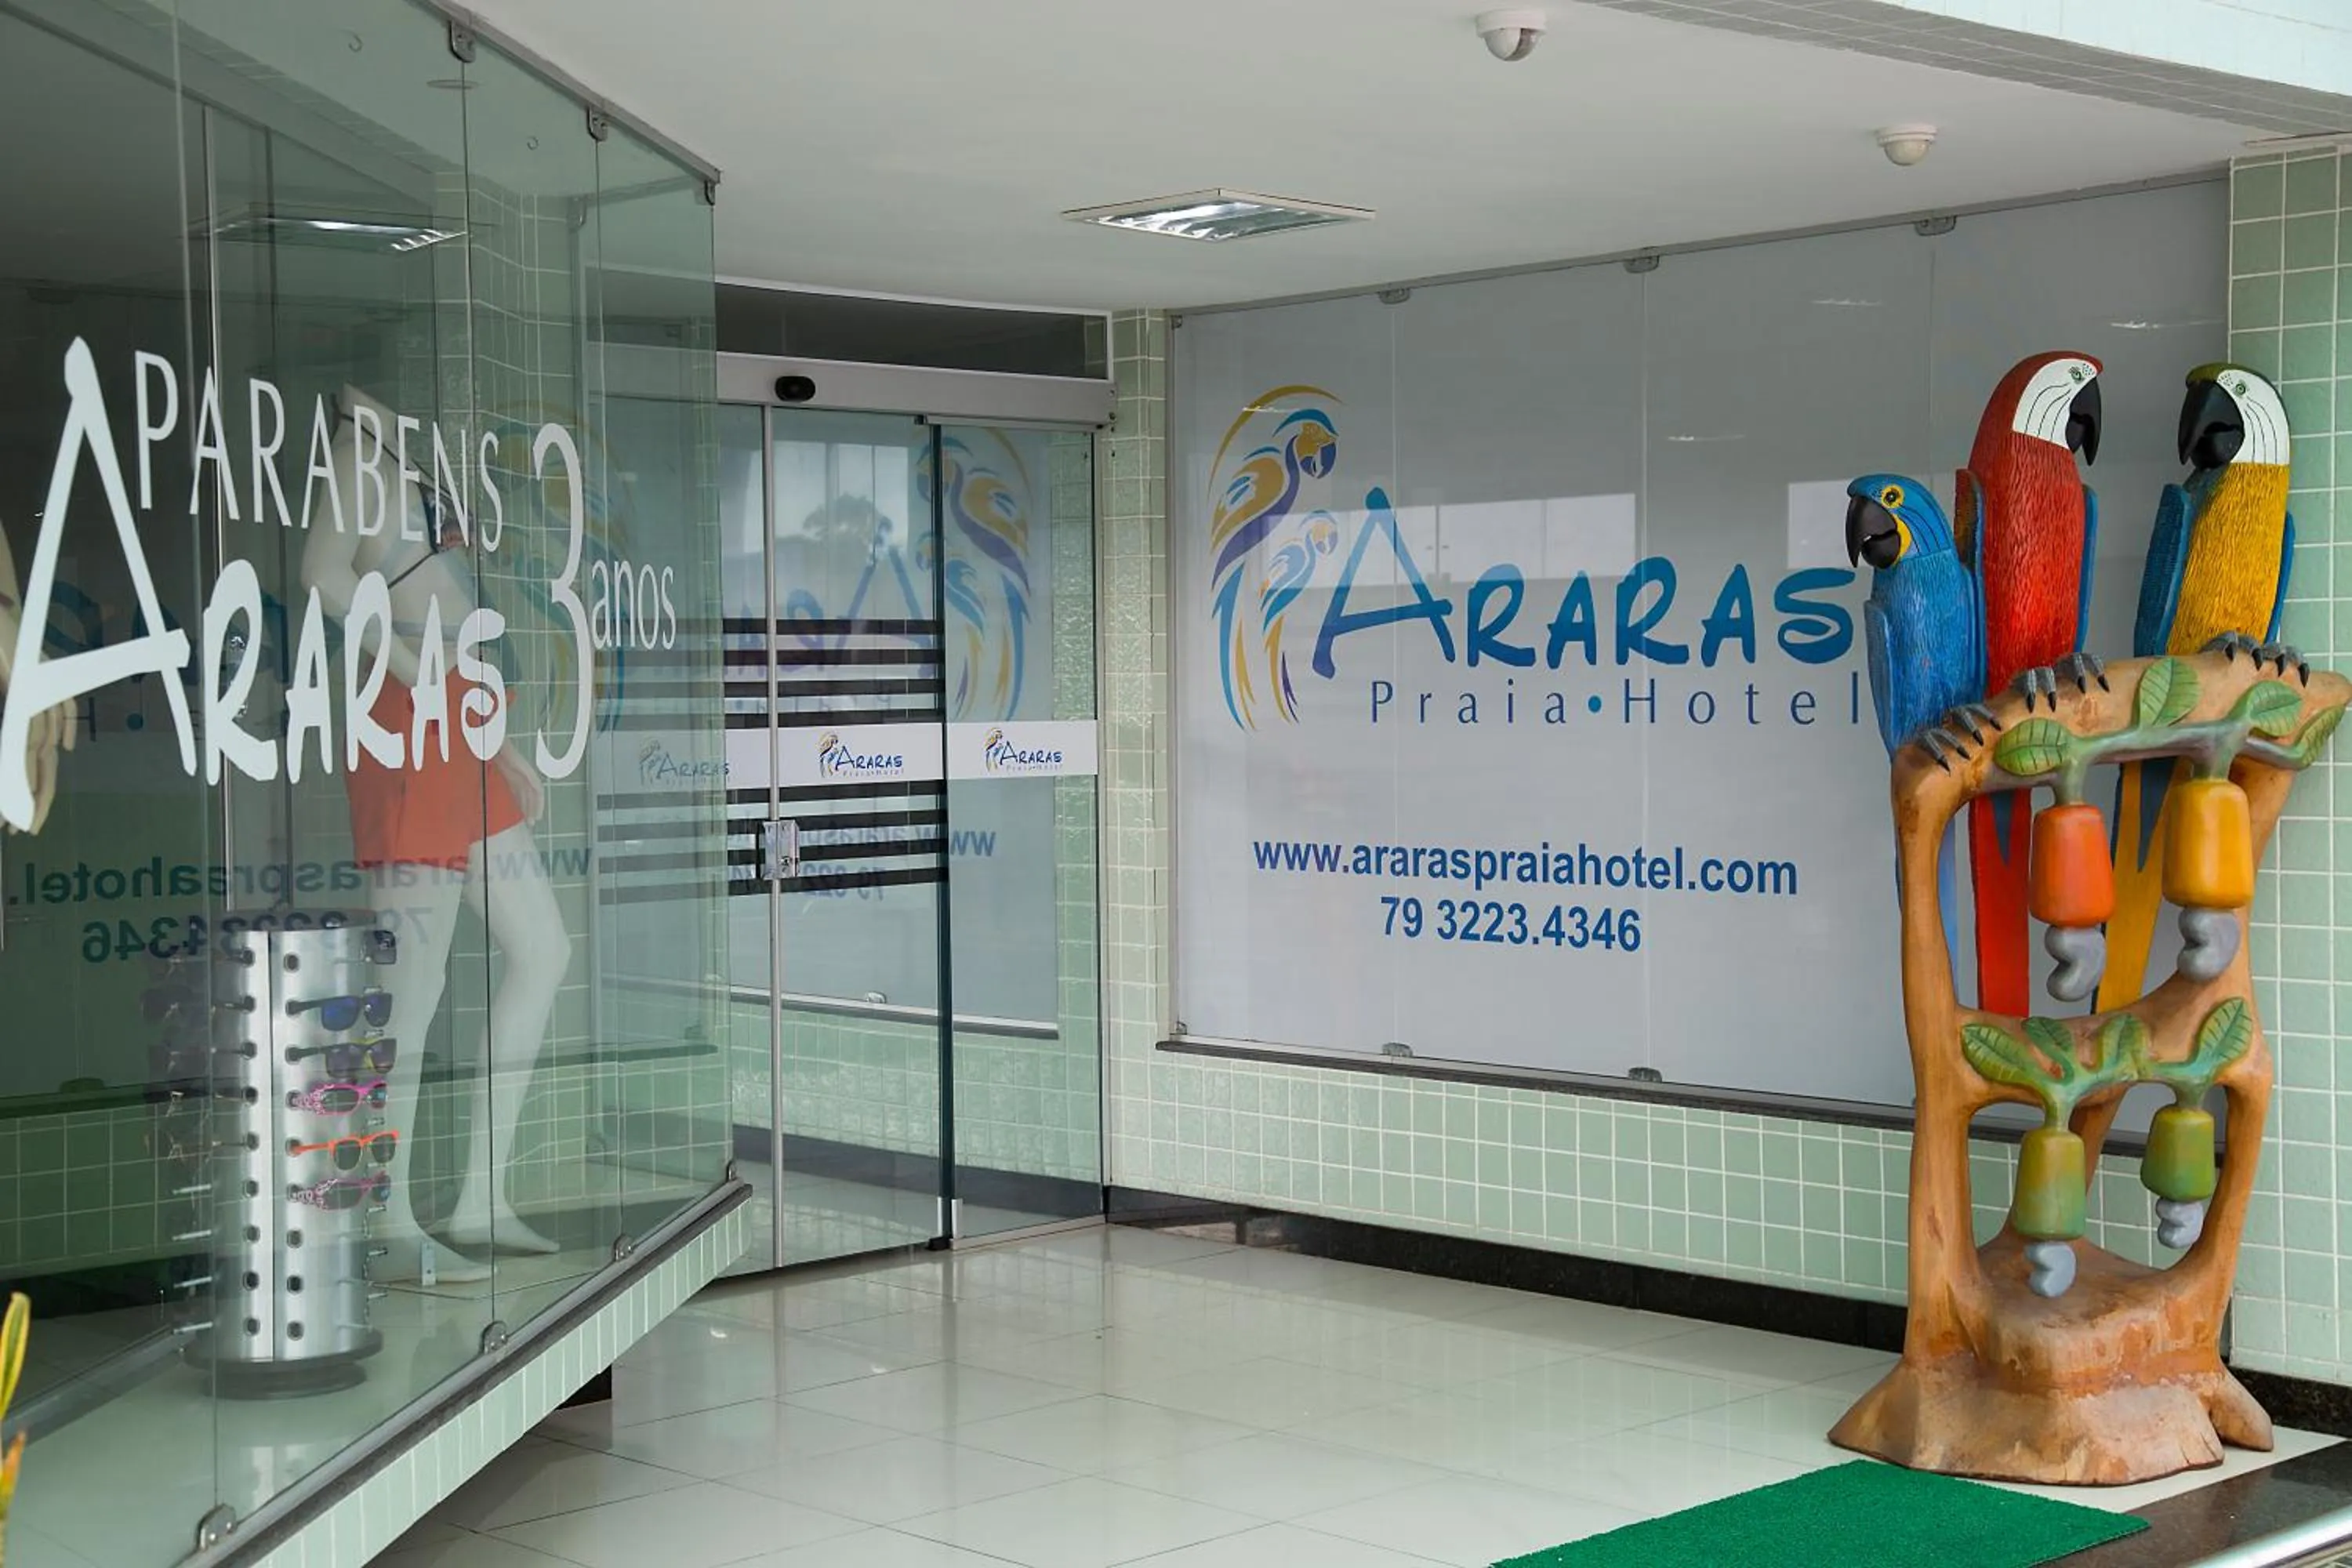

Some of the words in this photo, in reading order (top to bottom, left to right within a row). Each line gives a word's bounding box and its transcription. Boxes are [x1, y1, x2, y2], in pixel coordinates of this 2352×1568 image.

[135, 350, 503, 552] PARABENS
[0, 336, 506, 832] ARARAS
[533, 423, 592, 779] 3
[591, 559, 677, 650] anos
[1312, 486, 1856, 680] ARARAS
[1370, 679, 1566, 724] Praia
[1624, 671, 1859, 724] Hotel
[834, 746, 903, 771] ARARAS
[1000, 740, 1063, 766] ARARAS
[1253, 840, 1798, 895] www.araraspraiahotel.com
[1381, 896, 1423, 938] 79
[1437, 900, 1642, 952] 3223.4346
